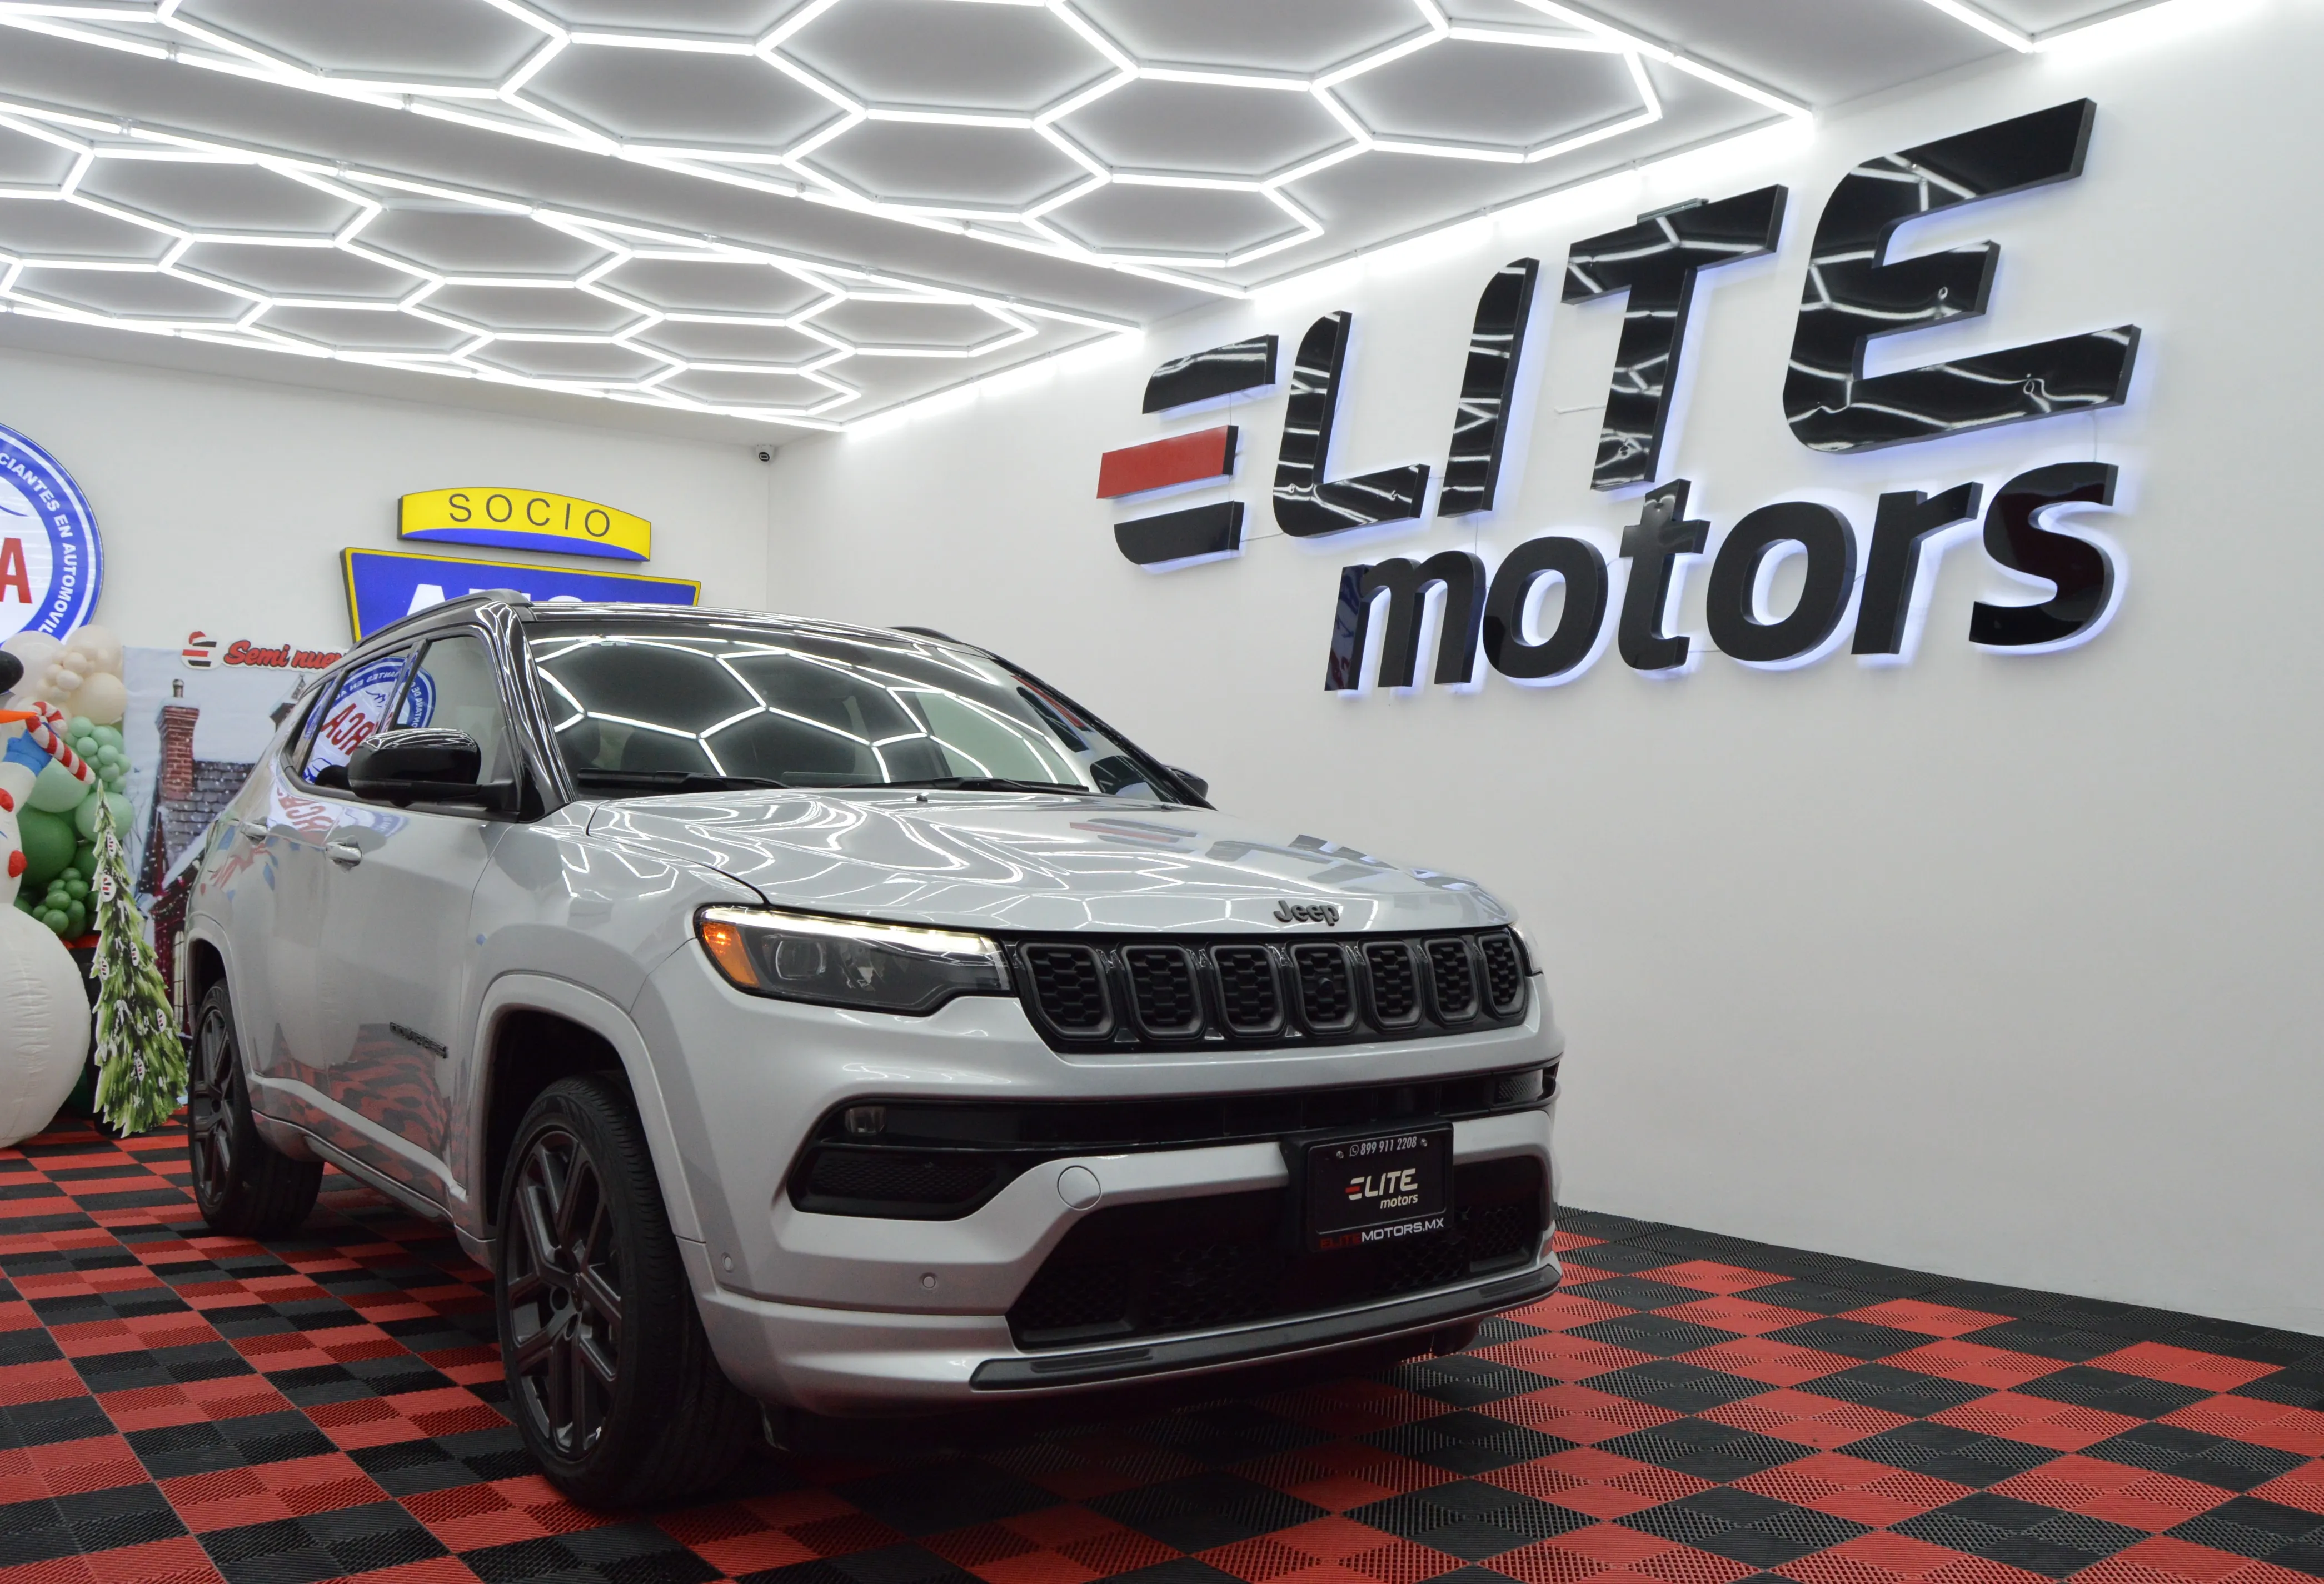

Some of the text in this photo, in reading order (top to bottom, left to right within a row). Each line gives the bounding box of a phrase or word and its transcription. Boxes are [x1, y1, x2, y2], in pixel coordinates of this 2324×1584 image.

[1097, 97, 2141, 566] ELITE
[54, 514, 73, 538] EN
[448, 493, 610, 537] SOCIO
[1324, 462, 2119, 691] motors
[223, 640, 290, 667] Semi
[1273, 900, 1340, 927] Jeep
[1360, 1136, 1417, 1156] 899 911 2208
[1345, 1168, 1418, 1201] ELITE
[1380, 1193, 1418, 1210] motors
